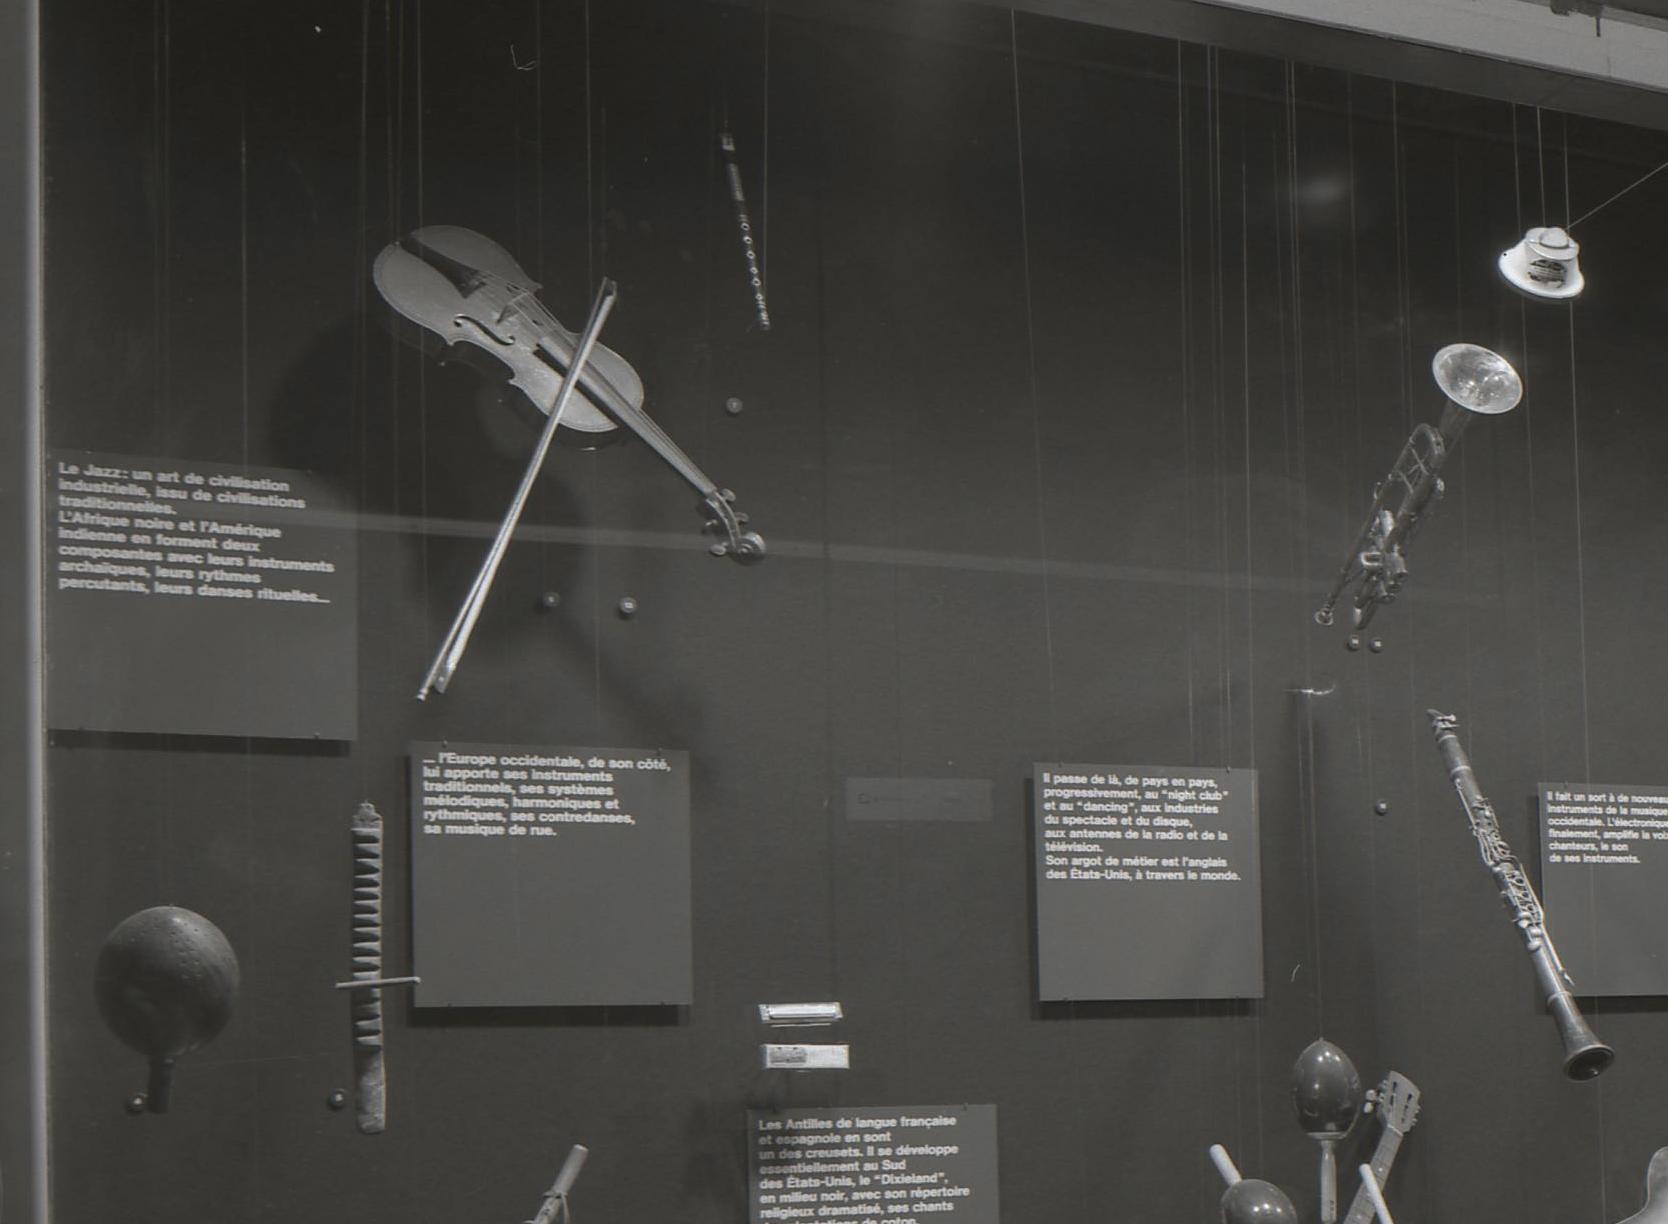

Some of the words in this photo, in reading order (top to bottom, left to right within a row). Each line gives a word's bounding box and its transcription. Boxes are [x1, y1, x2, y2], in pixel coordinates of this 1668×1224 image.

[58, 462, 79, 474] Le
[131, 471, 152, 480] un
[156, 472, 179, 482] art
[183, 473, 204, 484] de
[208, 476, 289, 490] civilisation
[58, 479, 150, 501] industrielle,
[155, 486, 187, 499] issu
[192, 489, 212, 500] de
[216, 492, 305, 507] civilisations
[58, 496, 176, 513] traditionnelles.
[58, 511, 129, 529] L'Afrique
[134, 518, 174, 529] noire
[178, 520, 195, 531] et
[200, 521, 281, 538] l'Amérique
[58, 527, 126, 541] indienne
[130, 534, 151, 544] en
[155, 534, 218, 548] forment
[221, 539, 260, 551] deux
[58, 546, 163, 563] composantes
[167, 553, 203, 563] avec
[207, 553, 244, 566] leurs
[247, 556, 334, 571] instruments
[58, 561, 150, 578] archaïques,
[155, 566, 194, 578] leurs
[198, 570, 261, 584] rythmes
[438, 752, 496, 769] l'Europe
[500, 755, 584, 771] occidentale,
[587, 757, 605, 767] de
[608, 760, 633, 768] son
[423, 766, 439, 777] lui
[443, 769, 499, 783] apporte
[503, 770, 527, 779] ses
[531, 770, 613, 781] instruments
[1043, 773, 1049, 782] Il
[1053, 775, 1087, 784] passe
[1090, 774, 1105, 783] de
[1108, 774, 1121, 785] là,
[1124, 775, 1138, 784] de
[1142, 778, 1168, 787] pays
[1171, 778, 1185, 786] en
[1188, 779, 1217, 788] pays,
[423, 781, 515, 797] traditionnels,
[519, 785, 544, 793] ses
[547, 784, 613, 799] systèmes
[423, 795, 508, 810] mélodiques,
[512, 797, 601, 813] harmoniques
[604, 799, 619, 809] et
[423, 809, 506, 824] rythmiques,
[510, 812, 535, 821] ses
[538, 812, 635, 823] contredanses,
[1044, 814, 1058, 824] du
[1062, 816, 1117, 825] spectacle
[1120, 816, 1132, 825] et
[1135, 816, 1149, 825] du
[1152, 816, 1192, 827] disque,
[424, 825, 441, 833] sa
[445, 824, 505, 835] musique
[508, 824, 526, 834] de
[530, 826, 556, 835] rue.
[1603, 830, 1639, 839] amplifie
[1642, 830, 1650, 839] la
[1548, 841, 1598, 851] chanteurs,
[1600, 842, 1608, 850] le
[1046, 855, 1068, 865] Son
[1071, 856, 1101, 869] argot
[1105, 856, 1119, 865] de
[1122, 856, 1158, 865] métier
[1161, 857, 1179, 866] est
[1182, 857, 1227, 868] l'anglais
[1549, 853, 1561, 862] de
[1583, 854, 1639, 862] instruments.
[1046, 869, 1067, 878] des
[1070, 868, 1132, 879] États-Unis,
[1135, 869, 1142, 879] à
[1145, 871, 1184, 879] travers
[1187, 870, 1197, 879] le
[1200, 871, 1240, 880] monde.
[862, 1162, 878, 1170] au
[880, 1159, 906, 1170] Sud
[759, 1195, 775, 1203] en
[779, 1192, 817, 1202] milieu
[820, 1190, 848, 1205] noir,
[851, 1191, 881, 1199] avec
[884, 1190, 906, 1198] son
[910, 1186, 969, 1202] répertoire
[760, 1207, 814, 1219] religieux
[818, 1203, 884, 1219] dramatisé,
[887, 1204, 909, 1212] ses
[912, 1201, 953, 1211] chants
